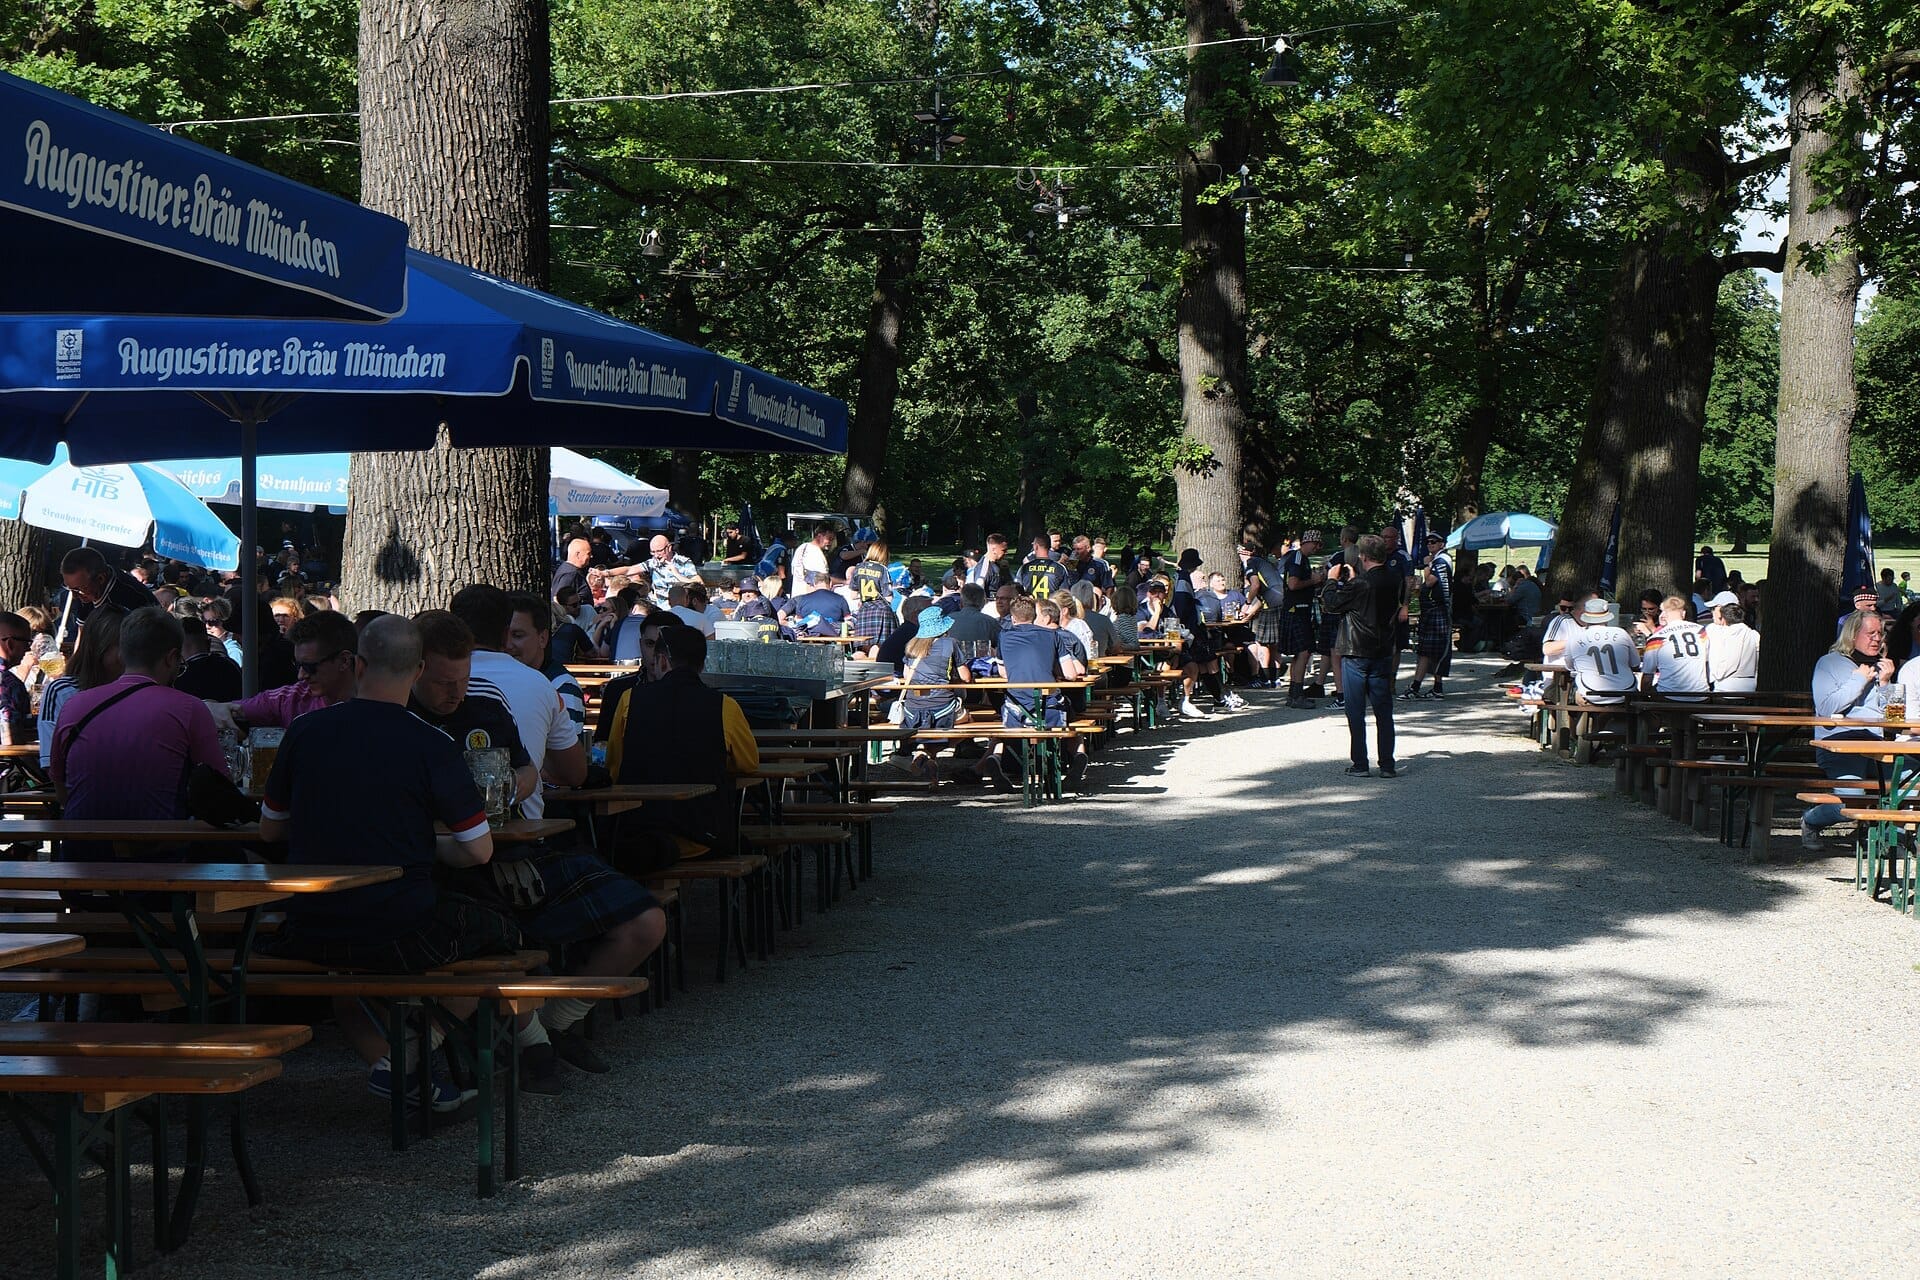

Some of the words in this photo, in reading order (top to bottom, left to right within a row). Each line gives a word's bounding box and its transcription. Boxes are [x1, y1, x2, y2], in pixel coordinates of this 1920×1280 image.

[246, 198, 340, 279] München
[343, 342, 446, 378] München
[650, 362, 687, 400] München
[71, 477, 120, 500] HTB
[259, 473, 332, 496] Brauhaus
[567, 489, 612, 505] Brauhaus
[41, 507, 88, 525] Brauhaus
[860, 578, 878, 602] 14
[1032, 574, 1050, 601] 14
[1576, 631, 1620, 648] KLOSE
[1668, 631, 1700, 659] 18
[1586, 643, 1620, 676] 11
